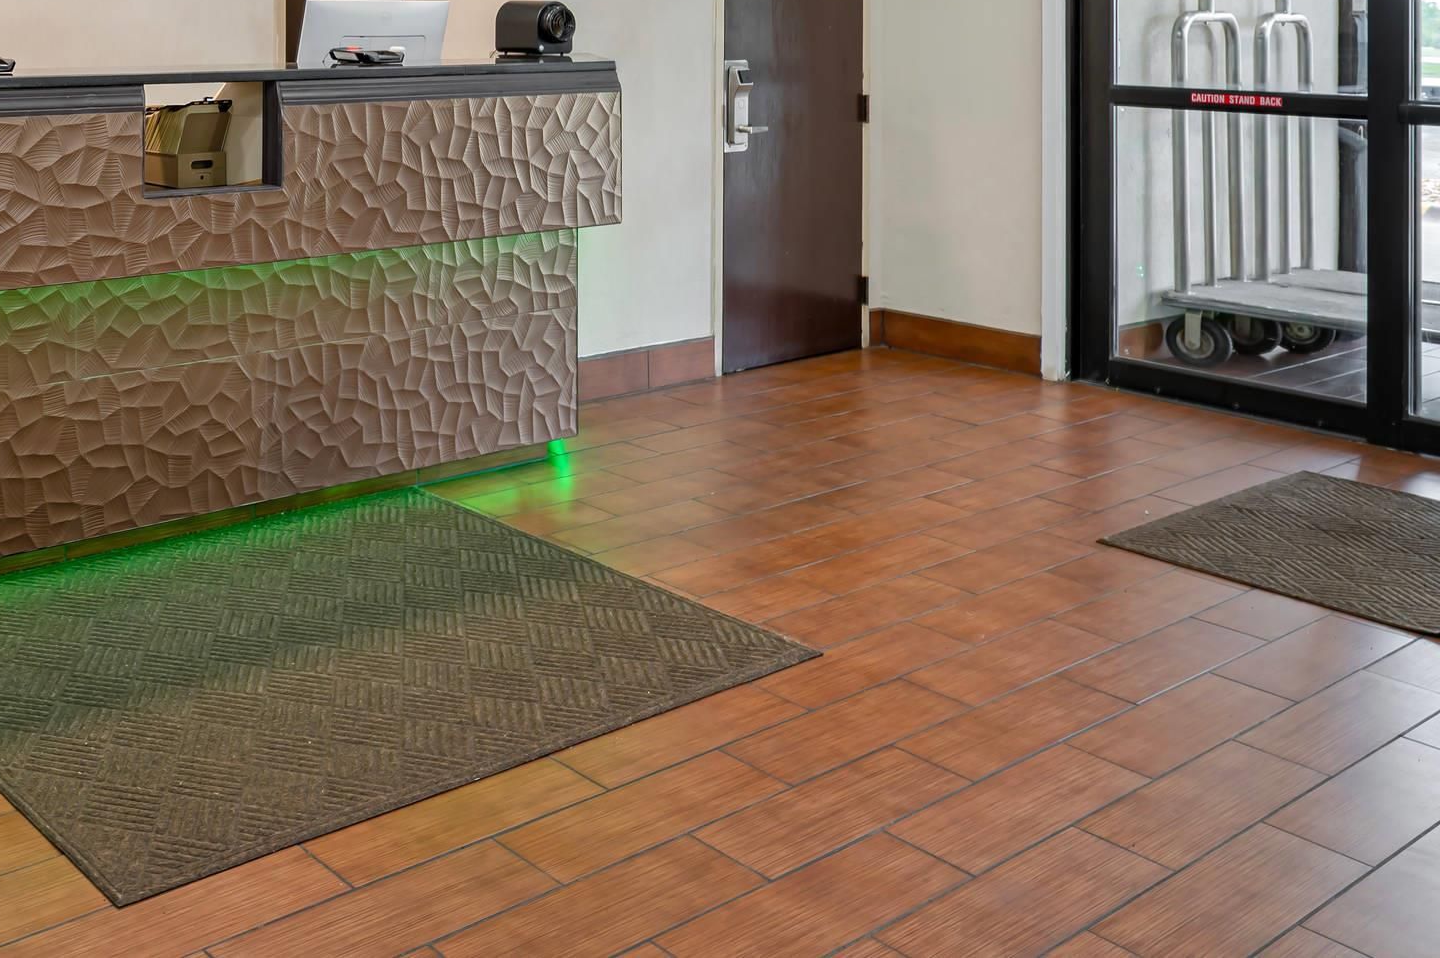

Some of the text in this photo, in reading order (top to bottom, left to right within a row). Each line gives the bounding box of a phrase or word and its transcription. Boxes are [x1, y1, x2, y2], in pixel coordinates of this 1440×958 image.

[1191, 93, 1282, 107] CAUTION STAND BACK
